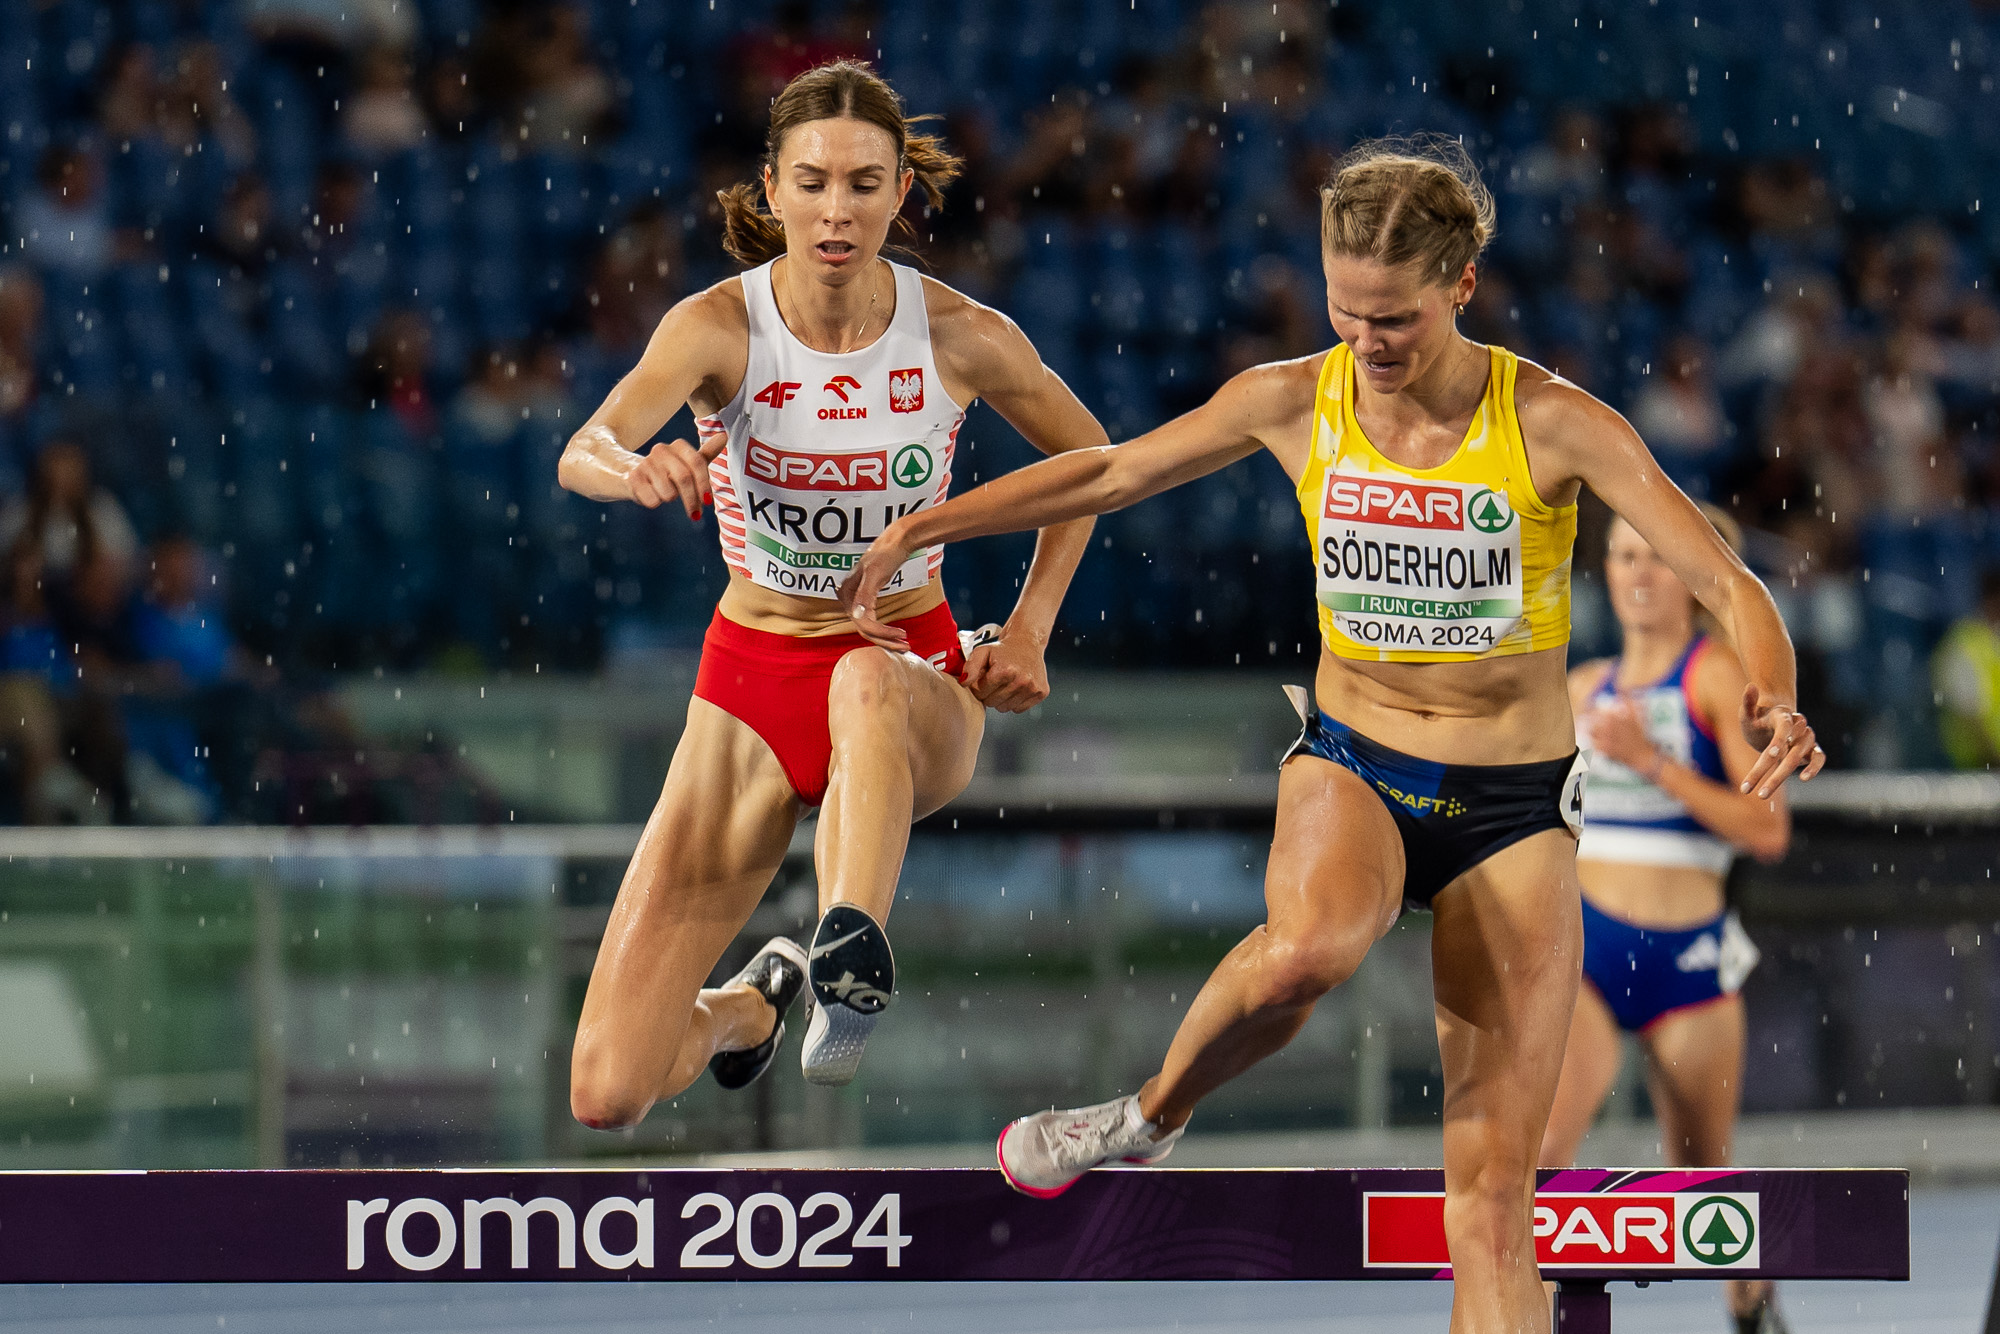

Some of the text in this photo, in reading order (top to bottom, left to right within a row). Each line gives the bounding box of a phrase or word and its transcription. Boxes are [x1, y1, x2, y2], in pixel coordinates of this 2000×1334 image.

[753, 380, 803, 410] 4F
[817, 407, 868, 421] ORLEN
[749, 446, 884, 487] SPAR
[1328, 481, 1461, 525] SPAR
[784, 550, 823, 567] RUN
[827, 553, 862, 569] CLE
[1322, 529, 1513, 590] SÖDERHOLM
[766, 560, 838, 593] ROMA
[1360, 595, 1366, 611] I
[1369, 596, 1408, 615] RUN
[1347, 619, 1496, 646] ROMA 2024
[1376, 780, 1446, 813] CRAFT
[346, 1192, 913, 1271] roma 2024
